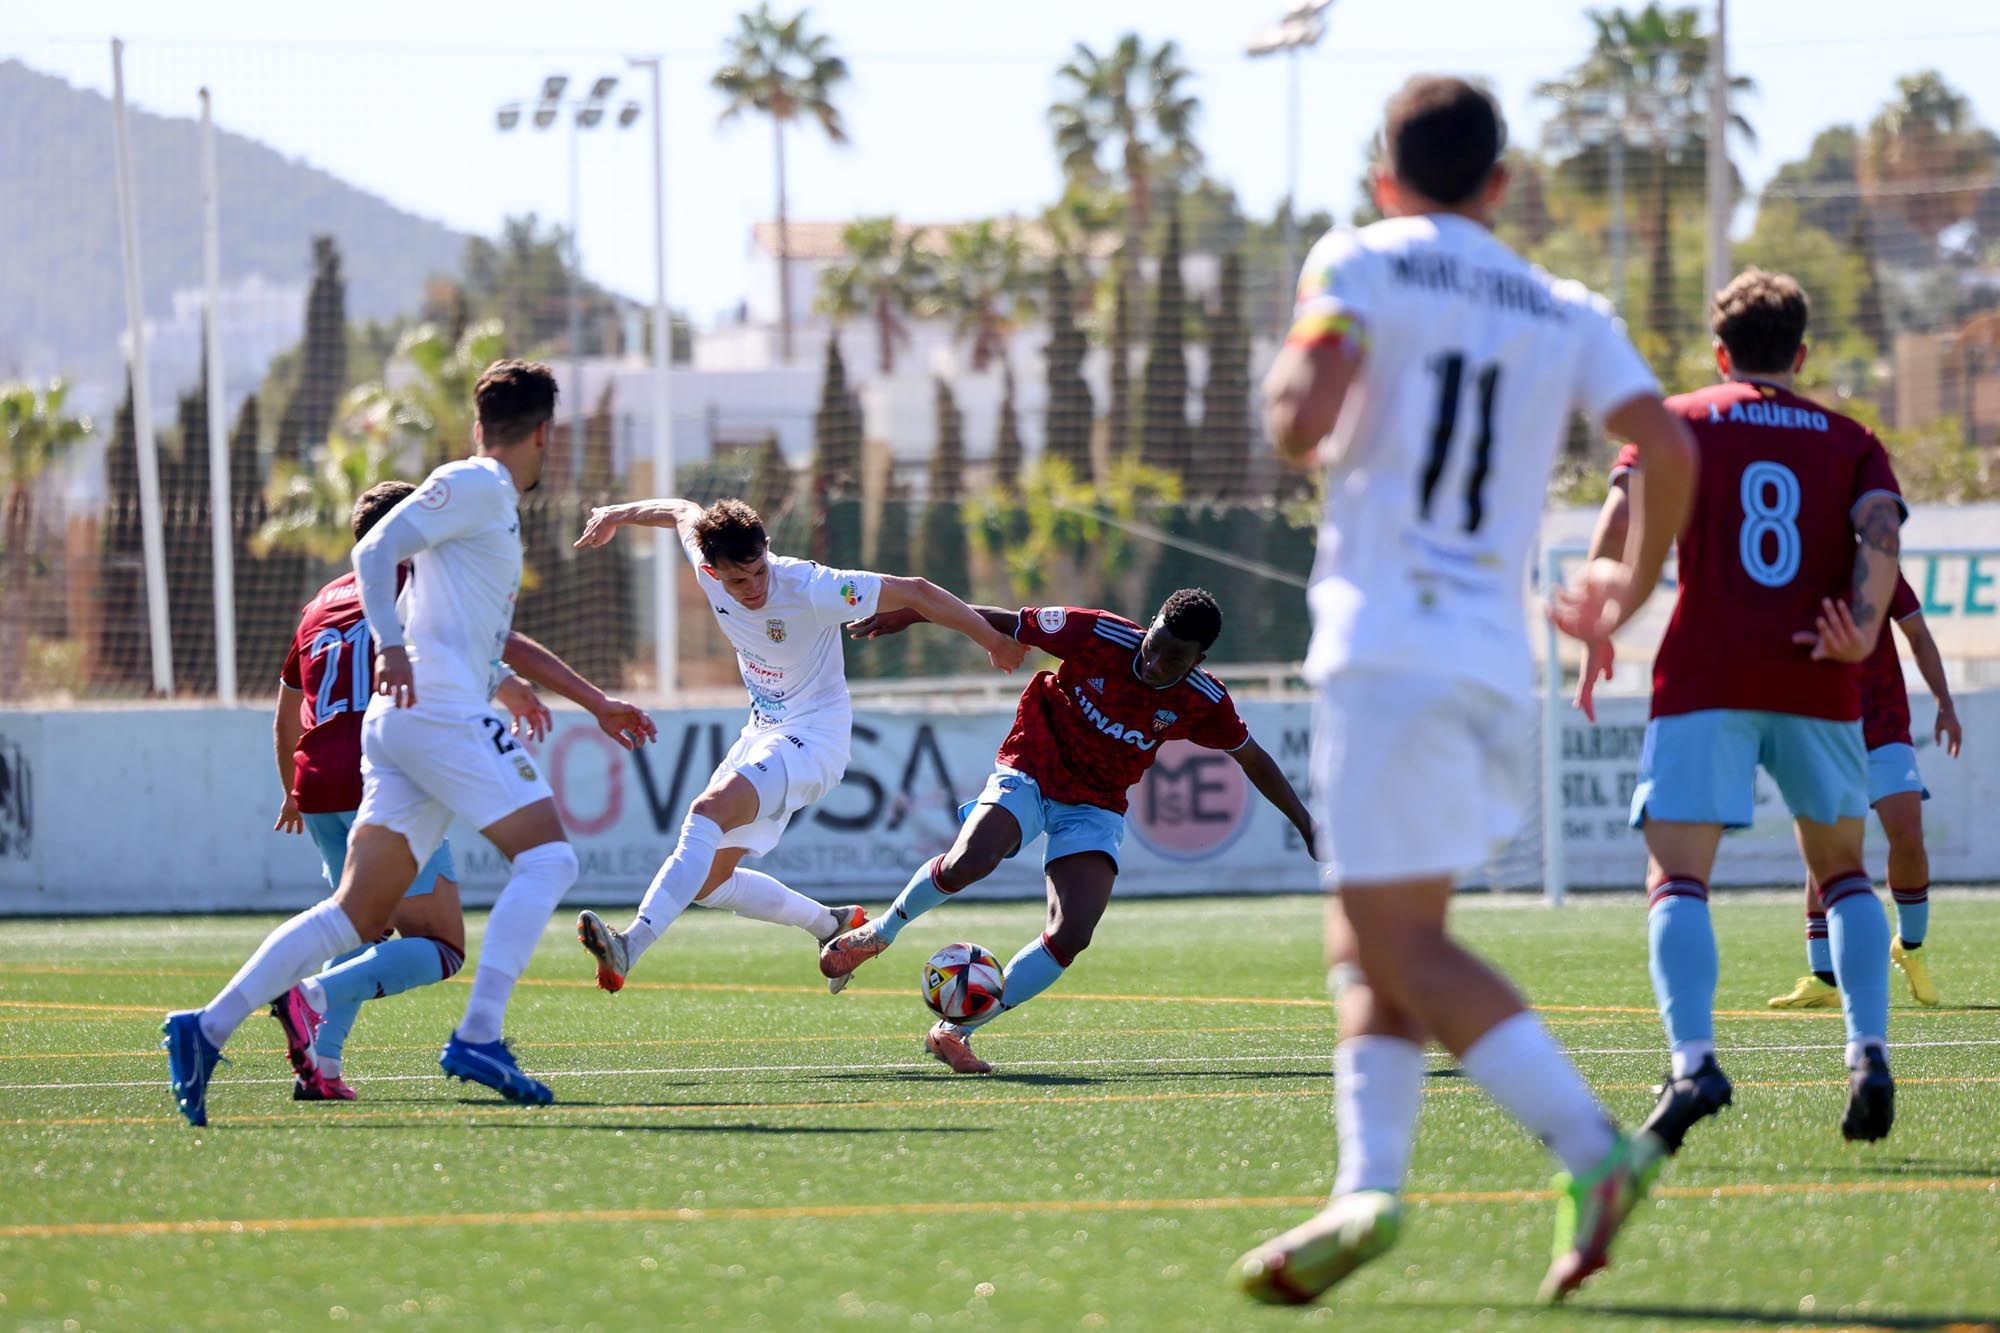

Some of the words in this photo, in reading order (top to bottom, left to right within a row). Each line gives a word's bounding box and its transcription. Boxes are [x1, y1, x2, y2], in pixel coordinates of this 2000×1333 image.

[1422, 350, 1503, 534] 11
[1729, 400, 1830, 432] AGÜERO
[1739, 460, 1801, 588] 8
[311, 618, 371, 725] 21
